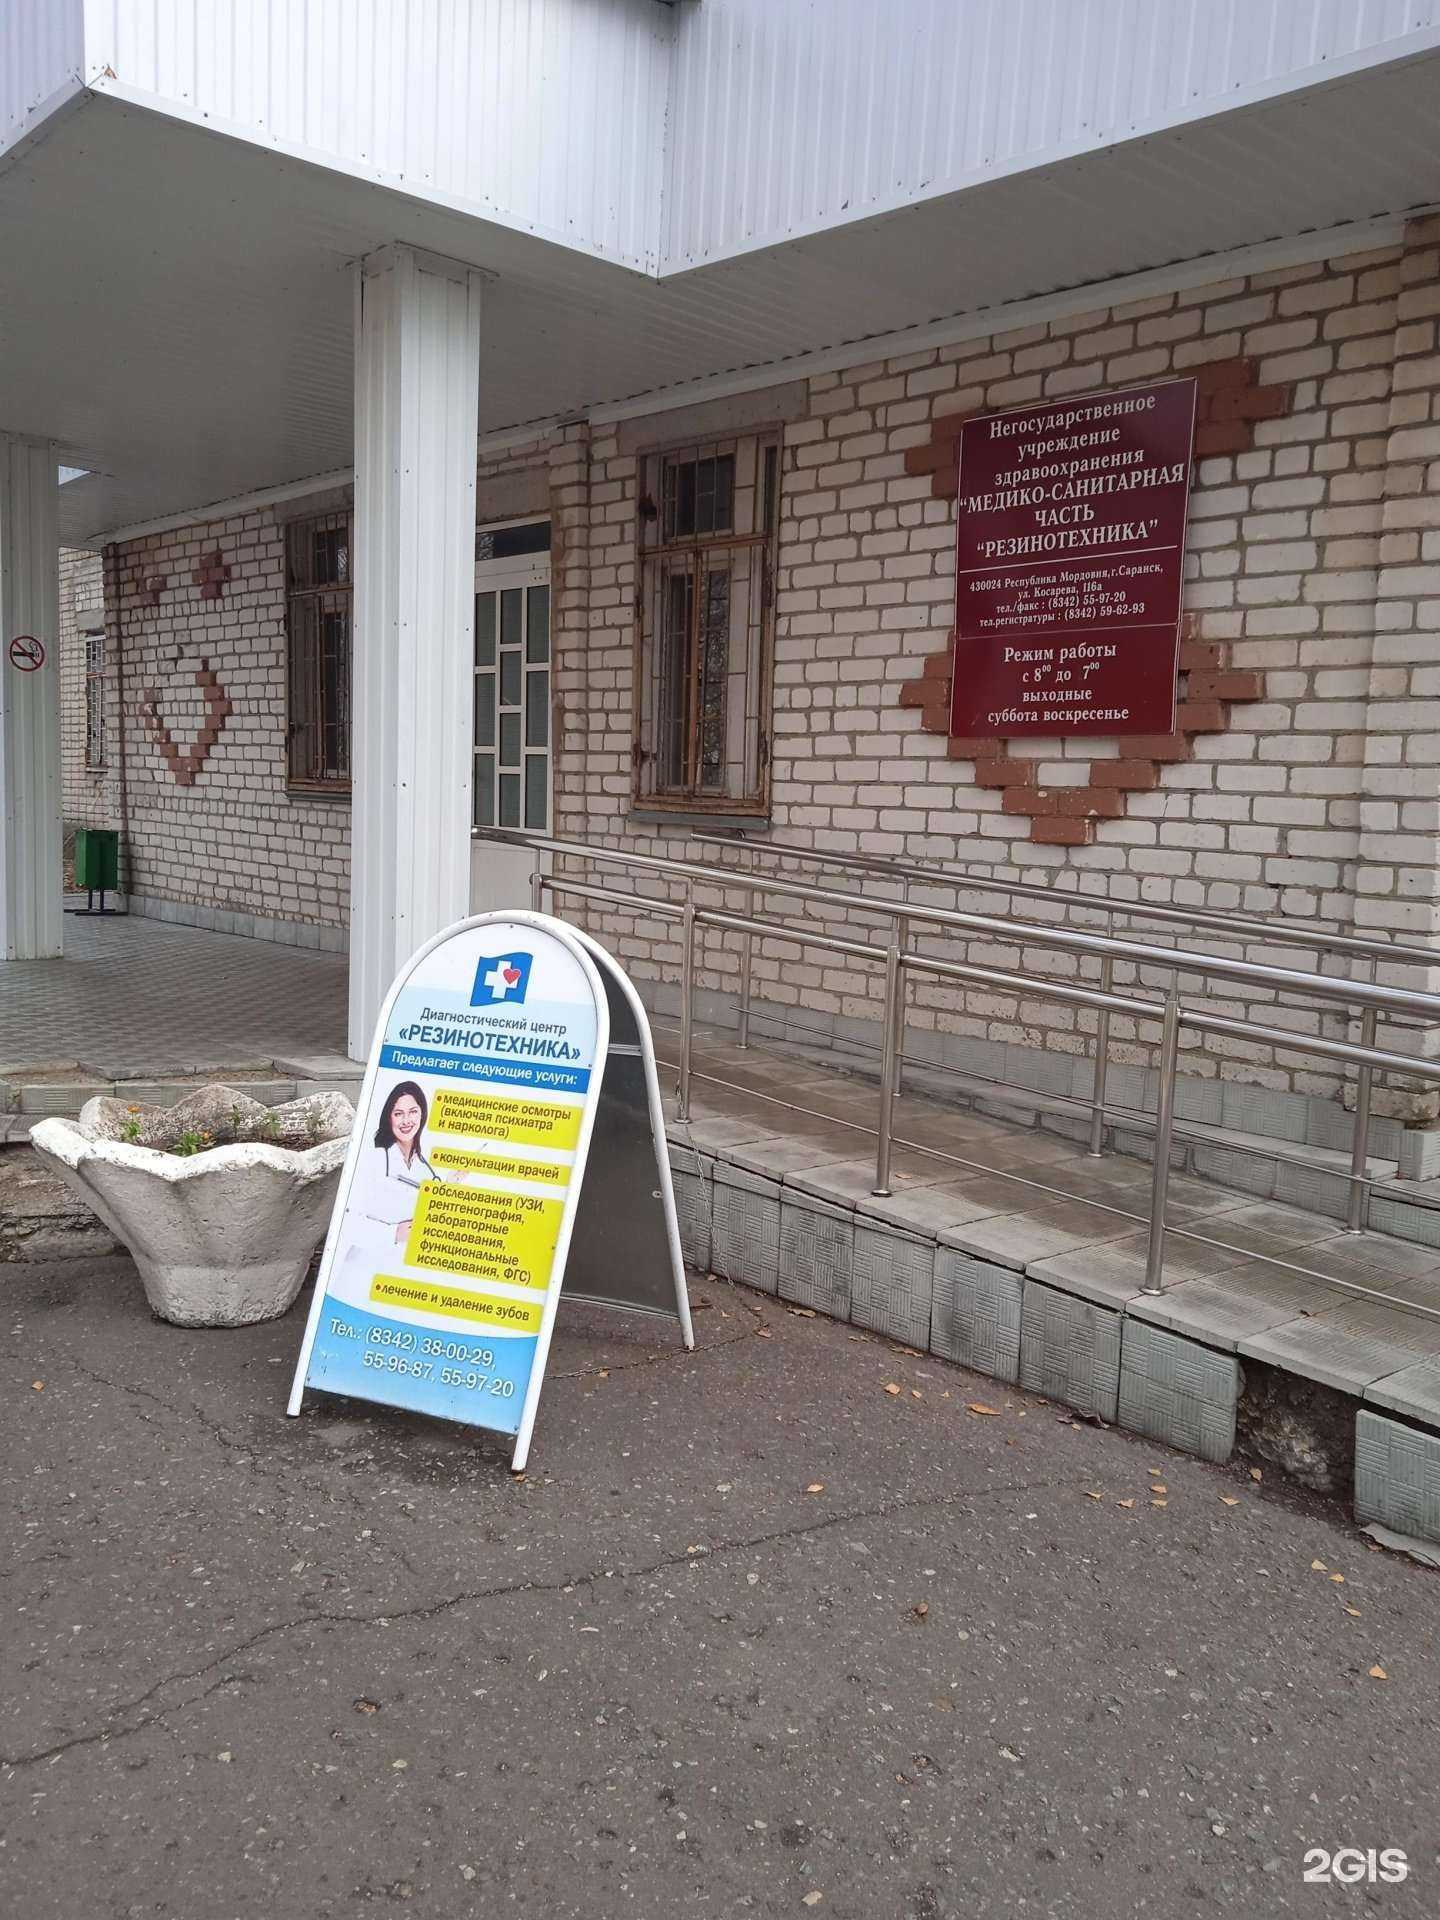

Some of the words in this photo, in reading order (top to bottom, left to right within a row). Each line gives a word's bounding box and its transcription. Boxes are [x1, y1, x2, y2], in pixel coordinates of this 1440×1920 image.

[989, 395, 1156, 439] Негосударственное
[1018, 427, 1121, 462] учреждение
[995, 449, 1145, 487] здравоохранения
[1034, 504, 1095, 527] ЧАСТЬ
[969, 579, 1001, 592] 430024
[1004, 575, 1057, 588] Республика
[1018, 591, 1031, 601] ул.
[1034, 586, 1079, 598] Косарева,
[1048, 595, 1080, 611] (8342)
[1083, 591, 1127, 606] 55-97-20
[1064, 606, 1097, 621] (8342)
[1100, 602, 1145, 617] 59-62-93
[1004, 646, 1054, 663] Режим
[1060, 642, 1117, 663] работы
[1022, 671, 1029, 683] с
[1055, 670, 1072, 683] до
[1022, 687, 1093, 703] выходные
[988, 708, 1039, 726] суббота
[1043, 708, 1129, 726] воскресенье
[420, 1007, 528, 1031] Диагностический
[530, 1020, 567, 1037] центр
[399, 1023, 581, 1061] «РЕЗИНОТЕХНИКА»
[391, 1050, 460, 1071] Предлагает
[462, 1061, 533, 1081] следующие
[535, 1069, 578, 1085] услуги:
[440, 1105, 493, 1122] (включая
[495, 1113, 554, 1131] психиатра
[443, 1095, 519, 1113] медицинские
[521, 1104, 571, 1121] осмотры
[438, 1119, 445, 1128] и
[448, 1120, 511, 1139] нарколога)
[439, 1151, 516, 1173] консультации
[518, 1163, 560, 1180] врачей
[428, 1199, 525, 1225] рентгенография,
[432, 1185, 513, 1207] обследования
[515, 1196, 545, 1214] (УЗИ,
[425, 1212, 510, 1236] лабораторные
[423, 1226, 506, 1251] исследования,
[419, 1240, 520, 1266] функциональные
[416, 1254, 500, 1279] исследования,
[503, 1267, 532, 1285] ФГС)
[381, 1284, 428, 1302] лечение
[430, 1293, 438, 1303] и
[440, 1295, 494, 1316] удаление
[495, 1304, 530, 1321] зубов
[365, 1326, 418, 1353] (8342)
[420, 1337, 496, 1370] 38-00-29,
[362, 1351, 436, 1383] 55-96-87,
[440, 1367, 515, 1399] 55-97-20
